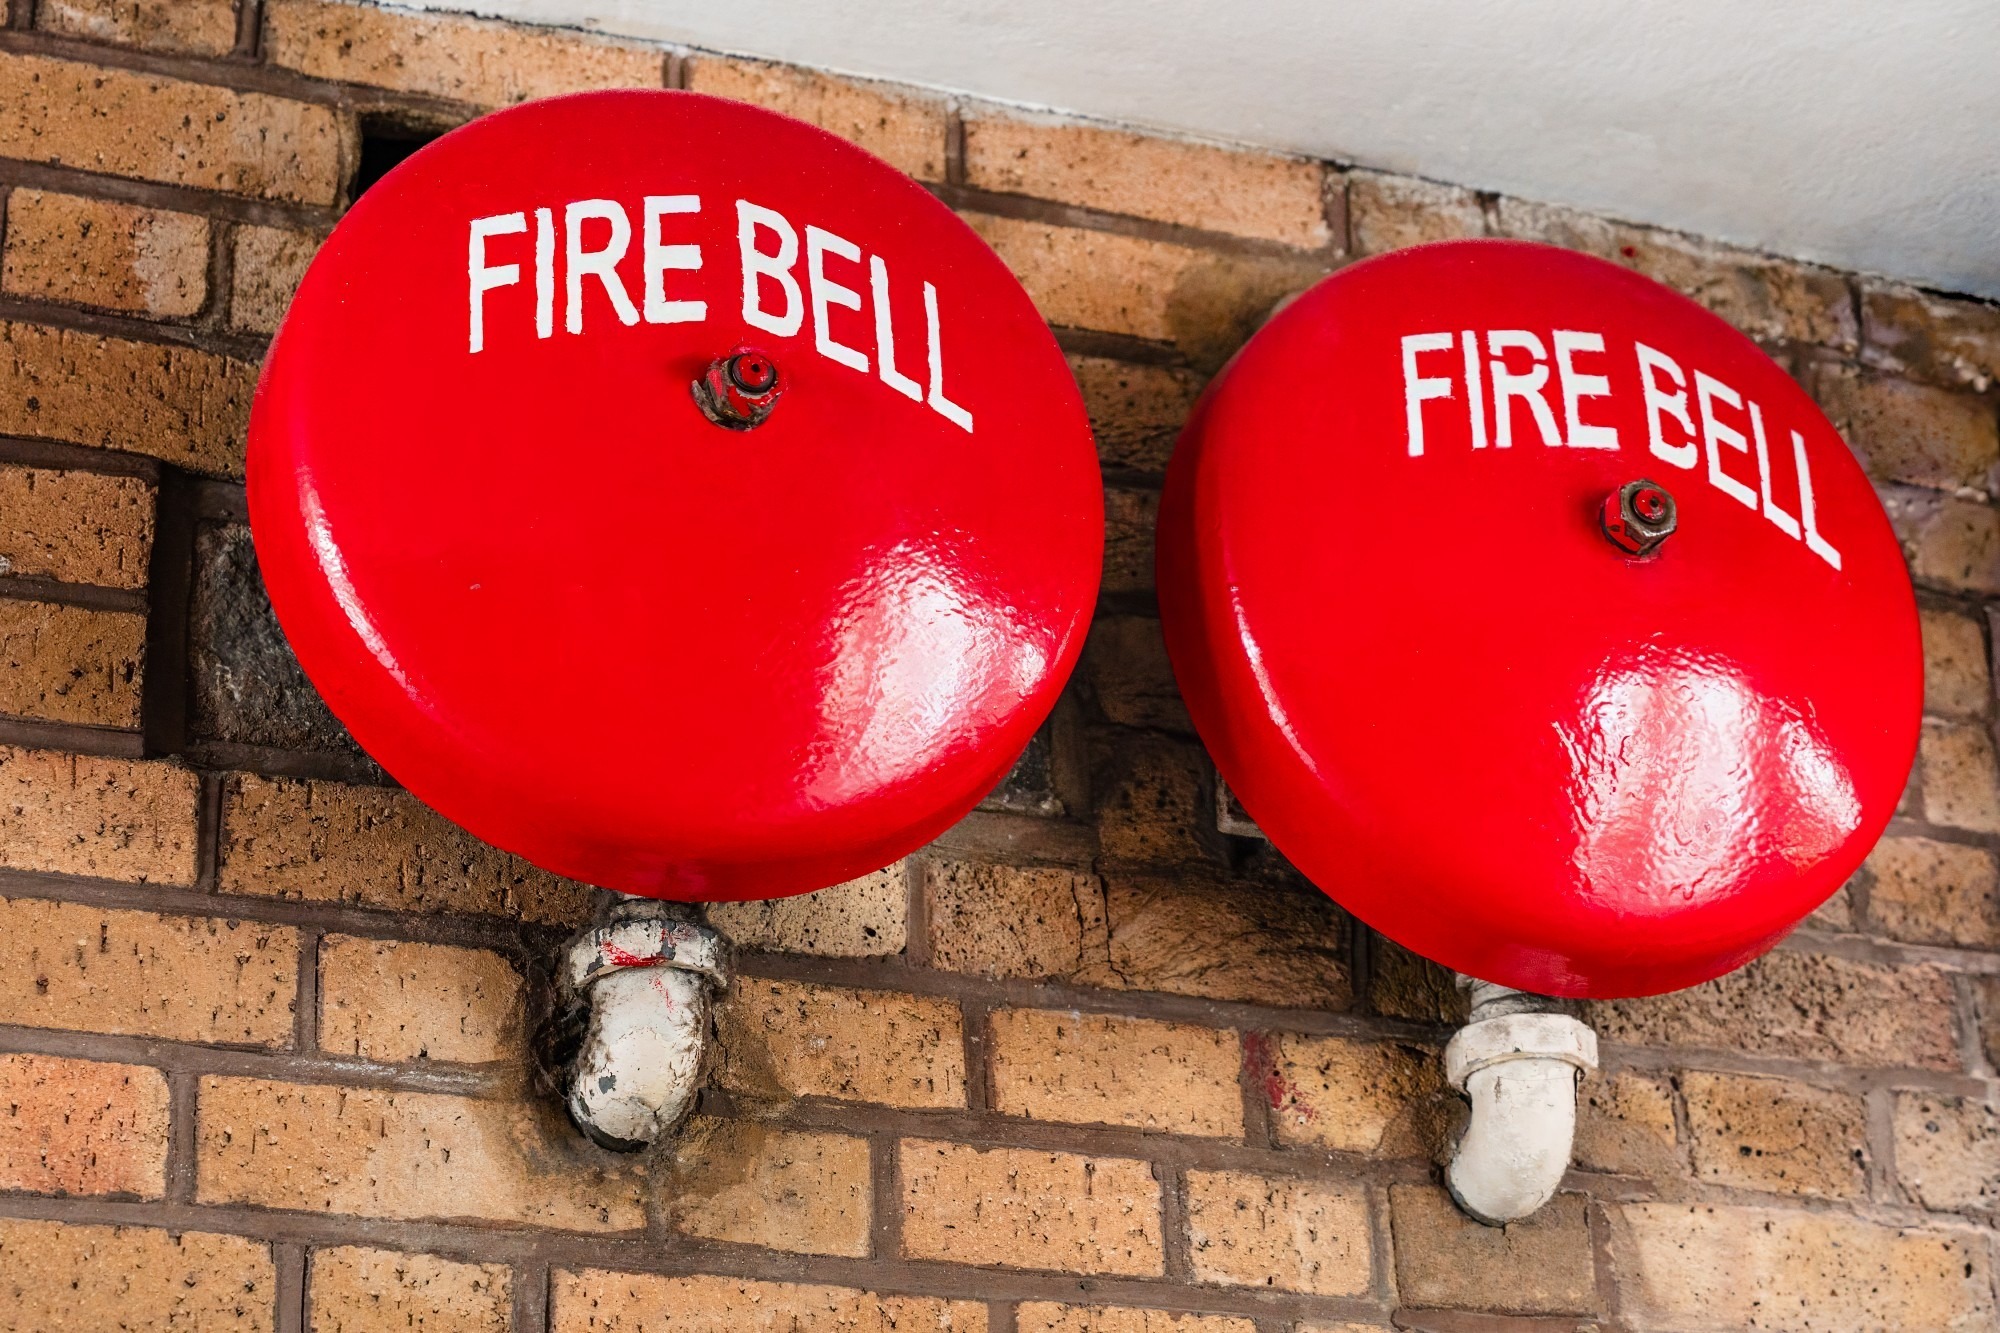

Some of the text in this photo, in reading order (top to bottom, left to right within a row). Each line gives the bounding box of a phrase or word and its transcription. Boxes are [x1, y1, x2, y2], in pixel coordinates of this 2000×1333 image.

[468, 194, 974, 434] FIRE BELL
[1401, 329, 1842, 571] FIRE BELL
